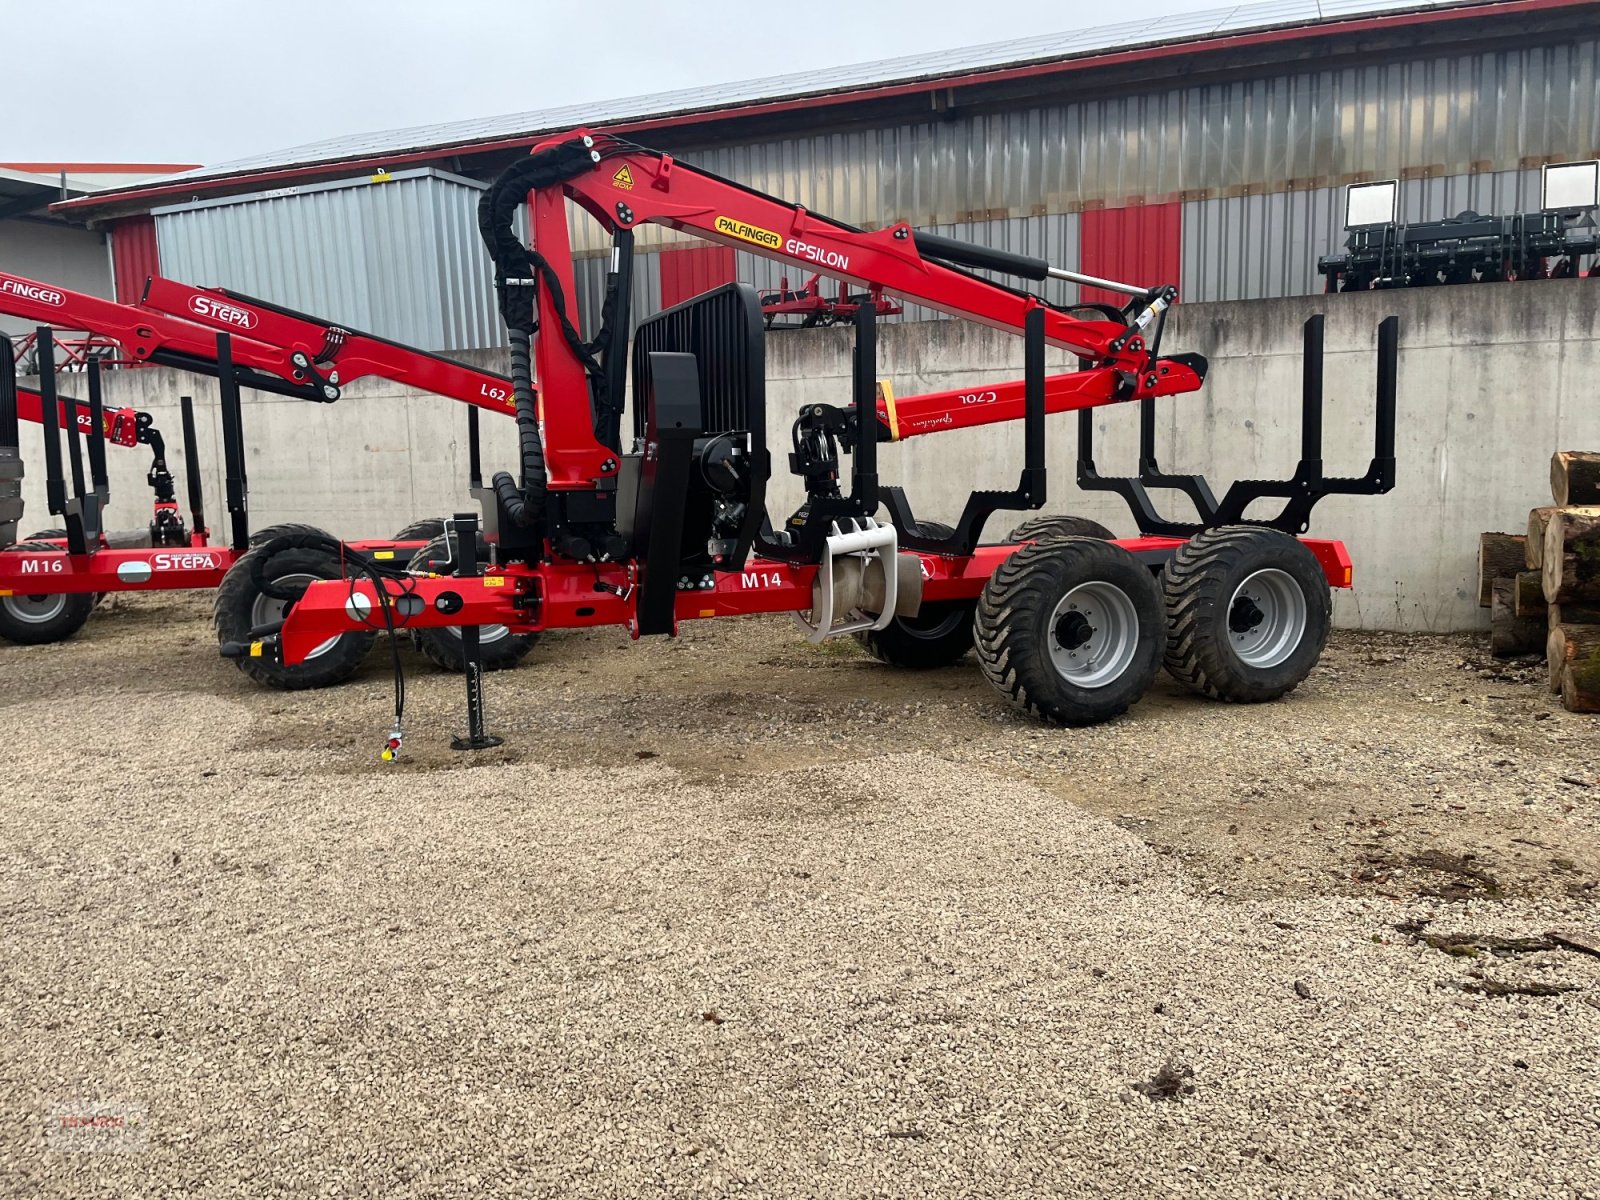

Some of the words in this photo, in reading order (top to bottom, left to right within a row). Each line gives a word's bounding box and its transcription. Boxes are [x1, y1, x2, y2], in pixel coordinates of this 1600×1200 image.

[718, 218, 779, 247] PALFINGER
[785, 239, 849, 270] EPSILON
[0, 280, 61, 304] FINGER
[194, 297, 250, 328] STEPA
[480, 383, 506, 402] L62
[958, 391, 997, 405] C70L
[76, 414, 92, 426] 62
[21, 559, 63, 574] M16
[155, 554, 215, 570] STEPA
[741, 572, 782, 589] M14
